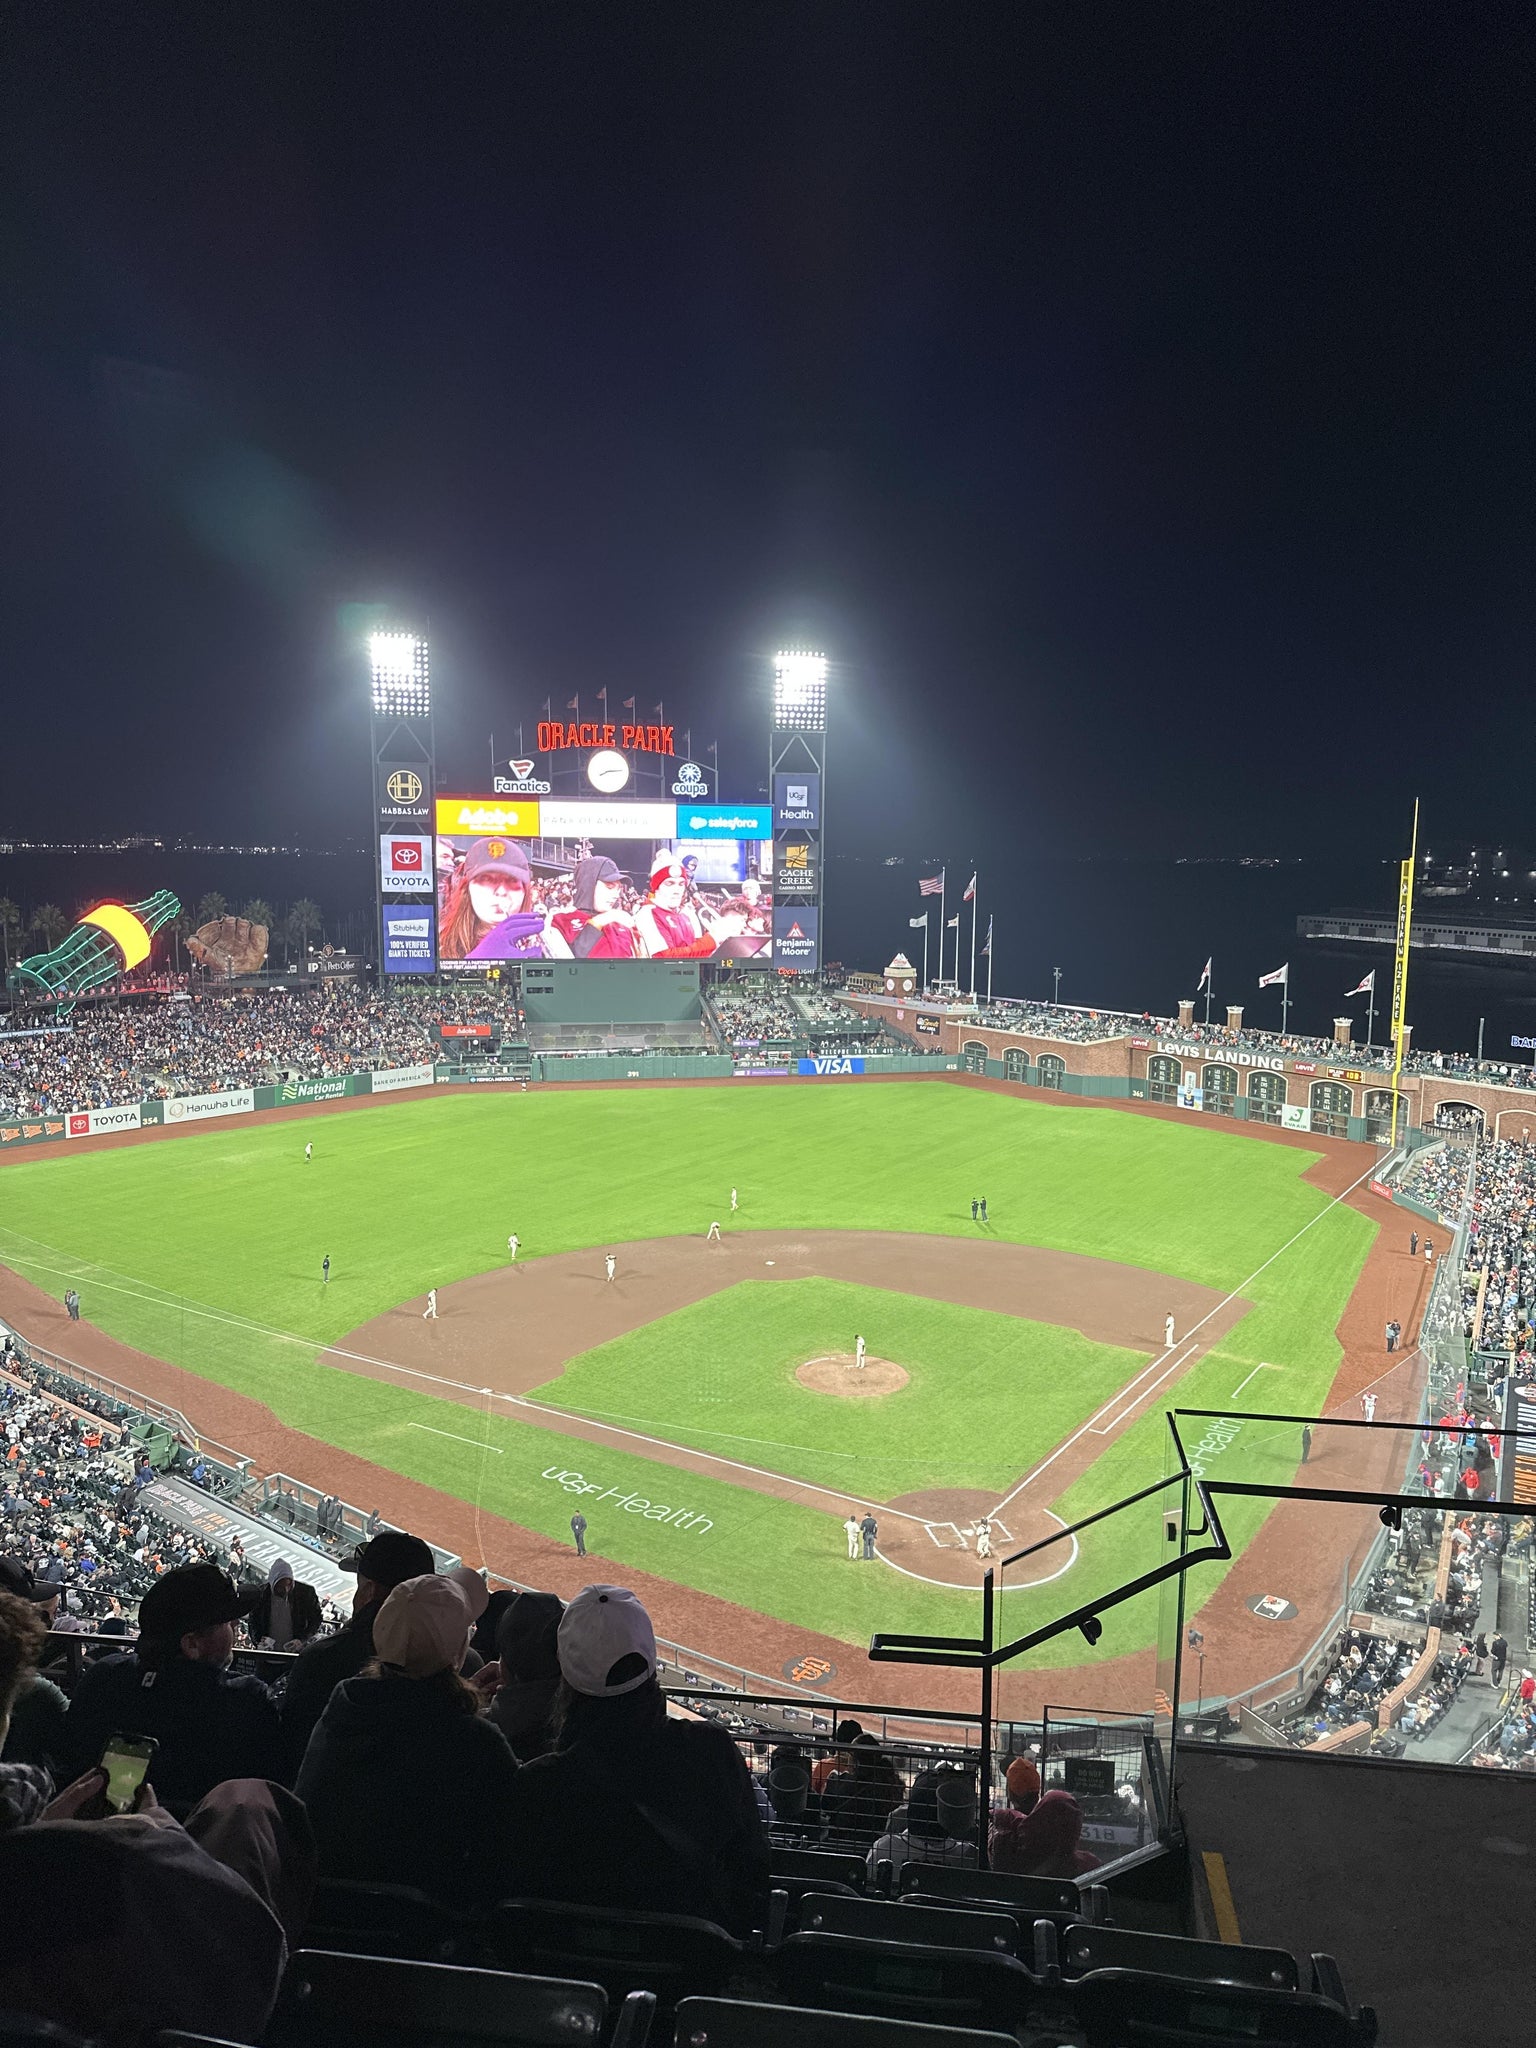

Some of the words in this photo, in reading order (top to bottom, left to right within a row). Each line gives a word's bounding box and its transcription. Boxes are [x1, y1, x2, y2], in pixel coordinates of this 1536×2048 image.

[537, 722, 616, 752] ORACLE
[621, 725, 676, 756] PARK
[495, 778, 550, 792] Fanatics
[673, 783, 707, 797] coupa
[381, 807, 412, 815] HABBAS
[412, 807, 429, 816] LAW
[457, 807, 519, 826] Adobe
[780, 809, 814, 820] Health
[708, 817, 758, 831] salesforce
[779, 869, 814, 877] CACHE
[384, 877, 430, 886] TOYOTA
[779, 877, 813, 885] CREEK
[392, 924, 424, 932] StubHub
[389, 940, 405, 949] 100%
[405, 940, 429, 949] VERIFIED
[776, 938, 815, 948] Benjamin
[388, 949, 408, 958] GIANTS
[408, 949, 431, 958] TICKETS
[781, 947, 810, 956] Moore
[777, 966, 798, 975] Coors
[456, 1027, 477, 1035] Adobe
[1204, 1048, 1285, 1071] LANDING
[812, 1059, 853, 1074] VISA
[397, 1074, 421, 1083] AMERICA
[297, 1079, 346, 1097] National
[314, 1093, 324, 1101] Car
[325, 1091, 344, 1100] Rental
[186, 1101, 228, 1114] Hanwha
[230, 1097, 250, 1107] Life
[93, 1112, 138, 1127] TOYOTA
[142, 1116, 158, 1126] 354
[1375, 1135, 1391, 1145] 309
[1373, 1184, 1390, 1196] ORACLE
[1186, 1417, 1246, 1462] Health
[145, 1483, 188, 1504] ORACLE
[180, 1499, 210, 1518] PARK
[541, 1465, 603, 1495] UCSF
[595, 1485, 714, 1535] Health
[214, 1524, 260, 1550] SAN
[248, 1540, 344, 1592] FRANCISCO
[1080, 1826, 1115, 1841] 318
